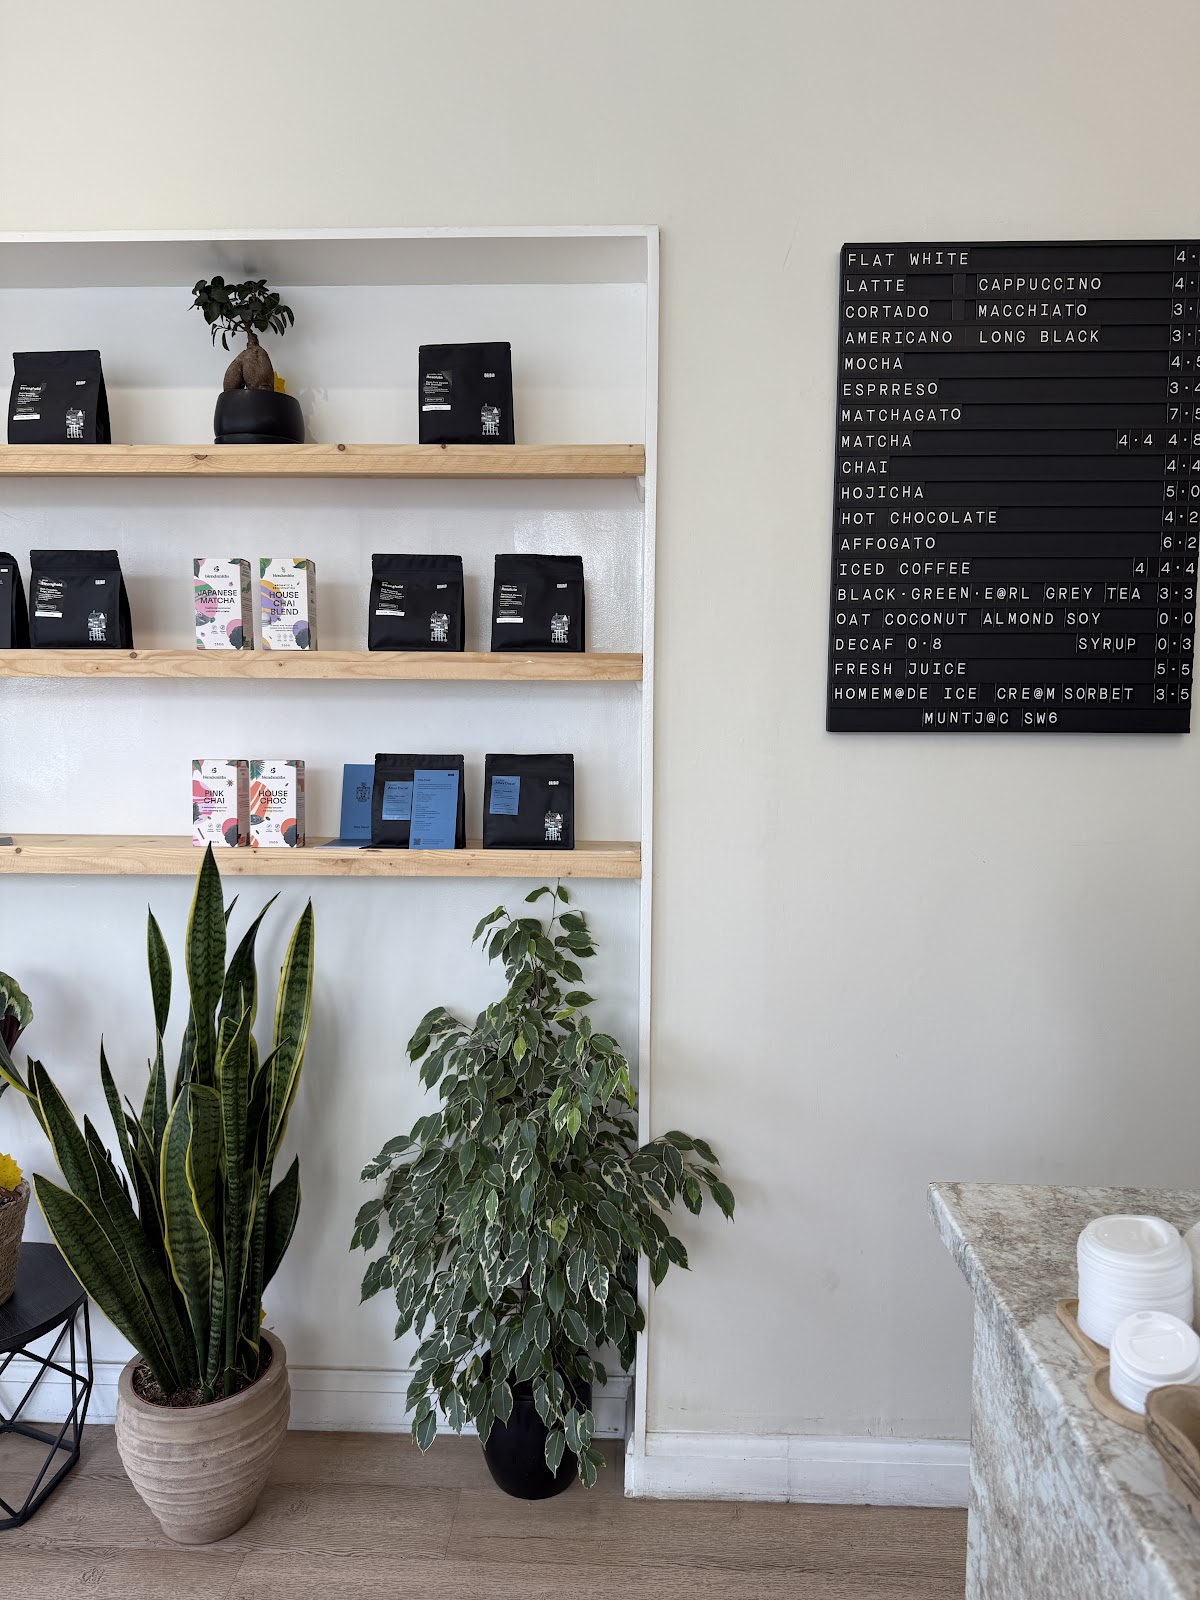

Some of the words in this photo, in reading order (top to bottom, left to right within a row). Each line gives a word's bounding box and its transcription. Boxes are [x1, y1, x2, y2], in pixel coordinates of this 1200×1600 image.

[848, 253, 895, 267] FLAT
[909, 251, 969, 266] WHITE
[846, 279, 905, 292] LATTE
[978, 277, 1101, 291] CAPPUCCINO
[845, 305, 929, 319] CORTADO
[978, 303, 1087, 318] MACCHIATO
[845, 330, 953, 345] AMERICANO
[979, 330, 1026, 343] LONG
[1040, 329, 1099, 343] BLACK
[844, 357, 903, 371] MOCHA
[843, 382, 938, 397] ESPRRESO
[841, 407, 961, 422] MATCHAGATO
[841, 434, 912, 448] MATCHA
[842, 460, 888, 474] CHAI
[841, 485, 924, 500] HOJICHA
[842, 512, 876, 525] HOT
[890, 511, 997, 525] CHOCOLATE
[840, 536, 936, 551] AFFOGATO
[839, 562, 885, 576] ICED
[899, 562, 971, 575] COFFEE
[1135, 562, 1145, 574] 4
[197, 589, 238, 597] JAPANESE
[269, 591, 299, 599] HOUSE
[1045, 586, 1093, 600] GREY
[1107, 587, 1141, 600] TEA
[273, 599, 296, 607] CHAI
[270, 608, 299, 616] BLEND
[836, 612, 871, 626] OAT
[884, 612, 968, 626] COCONUT
[982, 612, 1054, 625] ALMOND
[1066, 612, 1101, 625] SOY
[835, 638, 894, 651] DECAF
[1078, 637, 1136, 650] SYRUP
[835, 662, 892, 675] FRESH
[908, 662, 966, 675] JUICE
[834, 687, 928, 700] HOMEM@DE
[943, 687, 977, 700] ICE
[997, 687, 1055, 700] CRE@M
[1064, 687, 1134, 700] SORBET
[924, 711, 1009, 725] MUNTJ@C
[1024, 711, 1058, 725] SW6
[203, 797, 225, 805] CHAI
[259, 797, 287, 805] CHOC
